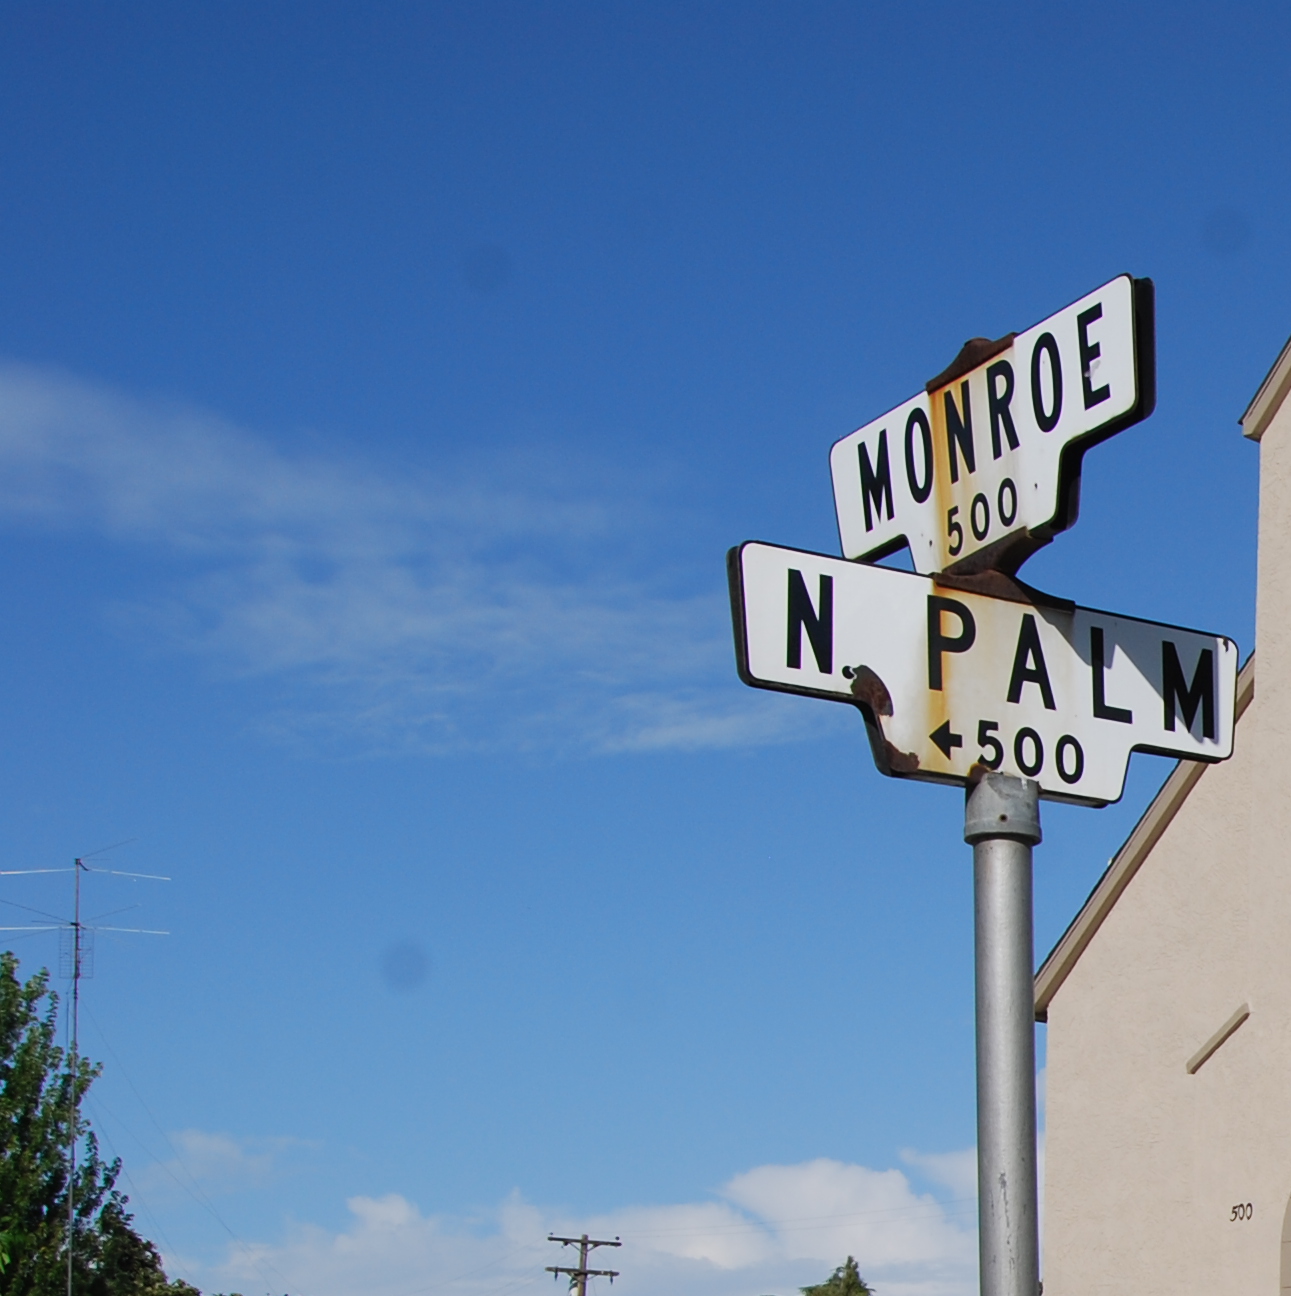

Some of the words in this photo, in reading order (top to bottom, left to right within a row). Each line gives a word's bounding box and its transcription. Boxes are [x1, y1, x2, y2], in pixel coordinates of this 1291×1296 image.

[857, 302, 1111, 532] MONROE
[948, 477, 1018, 556] 500
[927, 594, 1216, 738] PALM
[976, 720, 1084, 784] 500
[1229, 1202, 1253, 1222] 500
